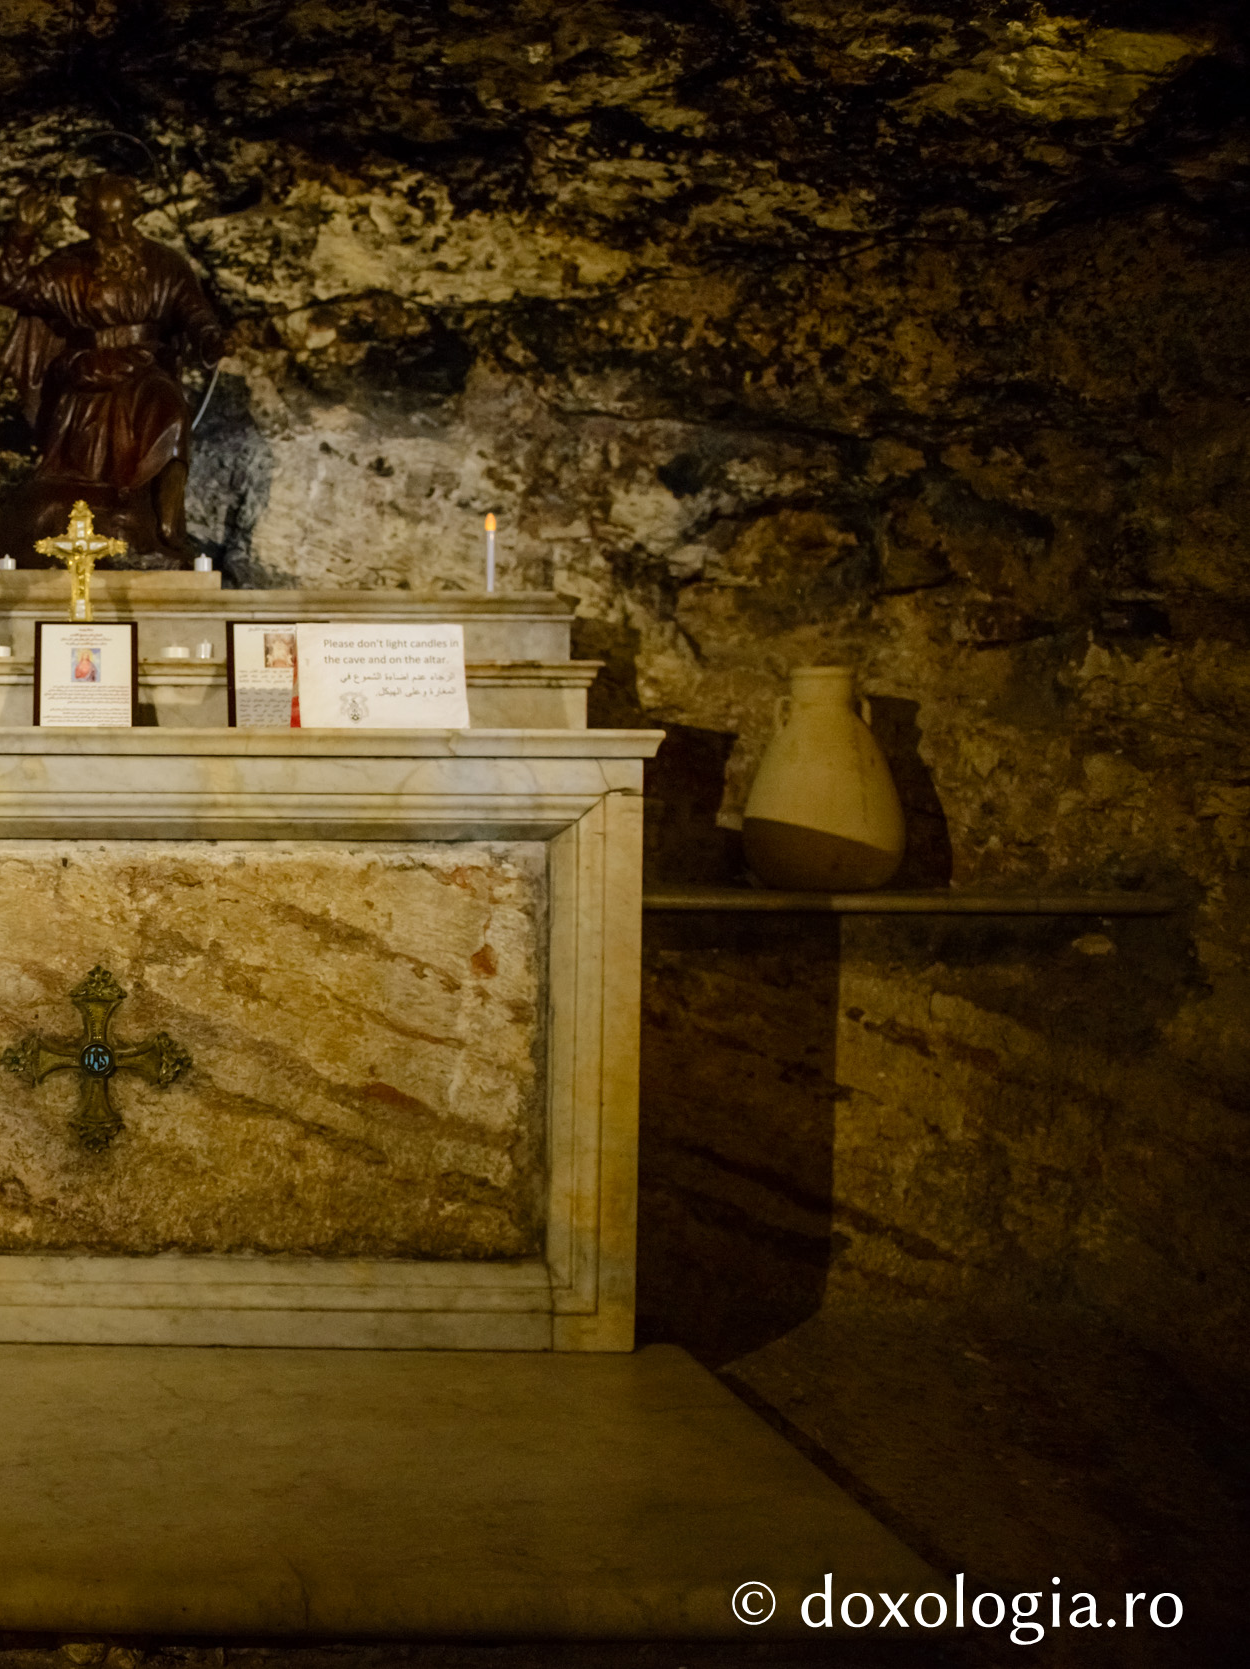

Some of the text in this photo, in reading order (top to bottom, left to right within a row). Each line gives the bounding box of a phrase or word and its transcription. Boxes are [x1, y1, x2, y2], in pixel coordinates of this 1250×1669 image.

[323, 639, 459, 650] Please don't light candles in
[324, 655, 340, 664] the
[342, 656, 366, 664] cave
[368, 655, 387, 664] and
[388, 656, 402, 664] on
[404, 655, 421, 664] the
